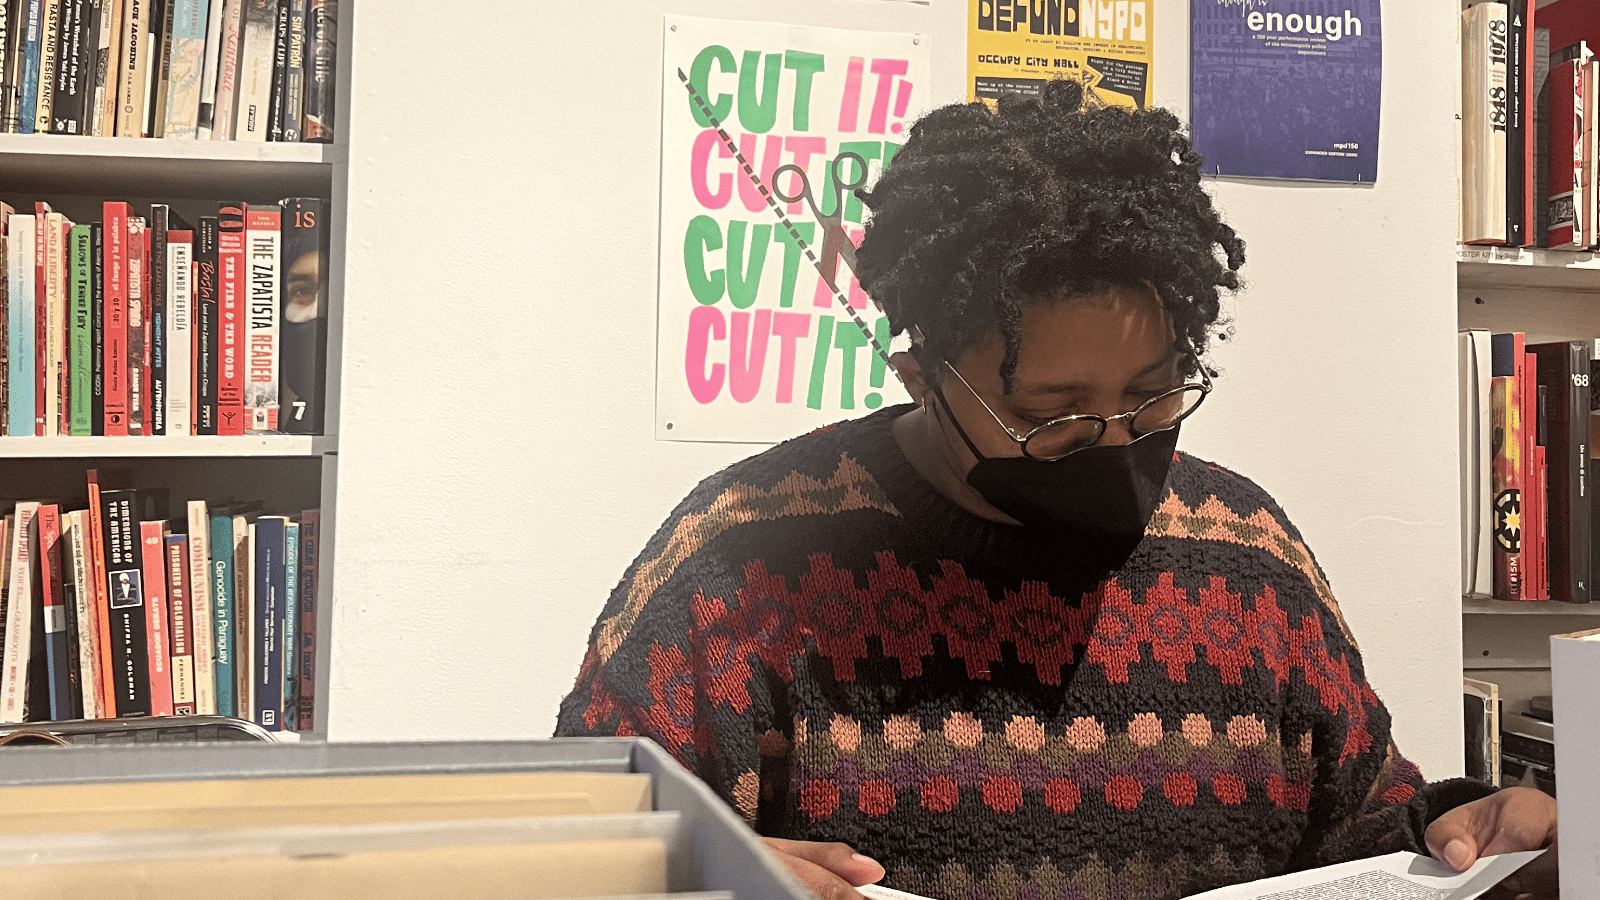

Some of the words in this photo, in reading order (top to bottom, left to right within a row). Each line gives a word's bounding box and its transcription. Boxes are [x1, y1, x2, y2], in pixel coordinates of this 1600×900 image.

[48, 4, 58, 31] RASTA
[279, 7, 288, 37] SCRAPS
[292, 16, 302, 32] SIN
[978, 0, 1079, 38] DEFUND
[1081, 0, 1146, 42] NYPD
[1247, 10, 1361, 41] enough
[46, 34, 55, 53] AND
[63, 33, 70, 41] by
[129, 23, 138, 70] JACOBINS
[278, 39, 286, 47] of
[290, 34, 303, 68] PATRÓN
[1488, 20, 1506, 65] 1978
[72, 57, 79, 65] of
[223, 24, 243, 92] Resistance
[277, 48, 285, 68] LIFE
[315, 47, 330, 82] Chile
[978, 55, 1020, 65] OCCUPY
[42, 55, 53, 110] RESISTANCE
[689, 45, 825, 134] CUT
[838, 56, 914, 134] IT!
[1489, 87, 1506, 133] 1848
[691, 128, 827, 215] CUT
[111, 217, 120, 244] palabra
[294, 204, 315, 228] is
[49, 219, 57, 248] LAND
[253, 237, 274, 259] THE
[78, 235, 89, 266] SHADOWS
[684, 215, 815, 309] CUT
[49, 256, 57, 298] LIBERTY
[112, 261, 120, 282] fuego
[176, 246, 188, 290] ENSEÑANDO
[200, 261, 216, 304] Basta!
[225, 257, 235, 278] THE
[78, 279, 88, 308] TENDER
[225, 282, 235, 308] FIRE
[252, 264, 274, 329] ZAPATISTA
[77, 310, 87, 329] FURY
[176, 295, 187, 331] REBELDÍA
[225, 312, 235, 320] &
[201, 332, 209, 352] Zapatista
[225, 323, 235, 344] THE
[225, 347, 235, 379] WORD
[251, 335, 273, 383] READER
[685, 305, 812, 404] CUT
[806, 315, 891, 410] IT!
[1571, 373, 1589, 387] '68
[292, 401, 306, 420] 7
[46, 513, 55, 529] The
[109, 501, 118, 518] THE
[121, 501, 132, 550] DIMENSIONS
[111, 521, 121, 563] AMERICAS
[287, 537, 295, 565] EPISODES
[125, 553, 132, 563] OF
[171, 545, 182, 586] PRISONERS
[17, 567, 25, 595] VOICES
[193, 537, 205, 611] COMMUNISM
[216, 560, 227, 607] Genocide
[173, 589, 182, 597] OF
[152, 597, 161, 630] DEBATE
[173, 600, 185, 653] COLONIALISM
[218, 609, 227, 618] in
[154, 631, 163, 672] ECUADOR
[217, 620, 228, 664] Paraguay
